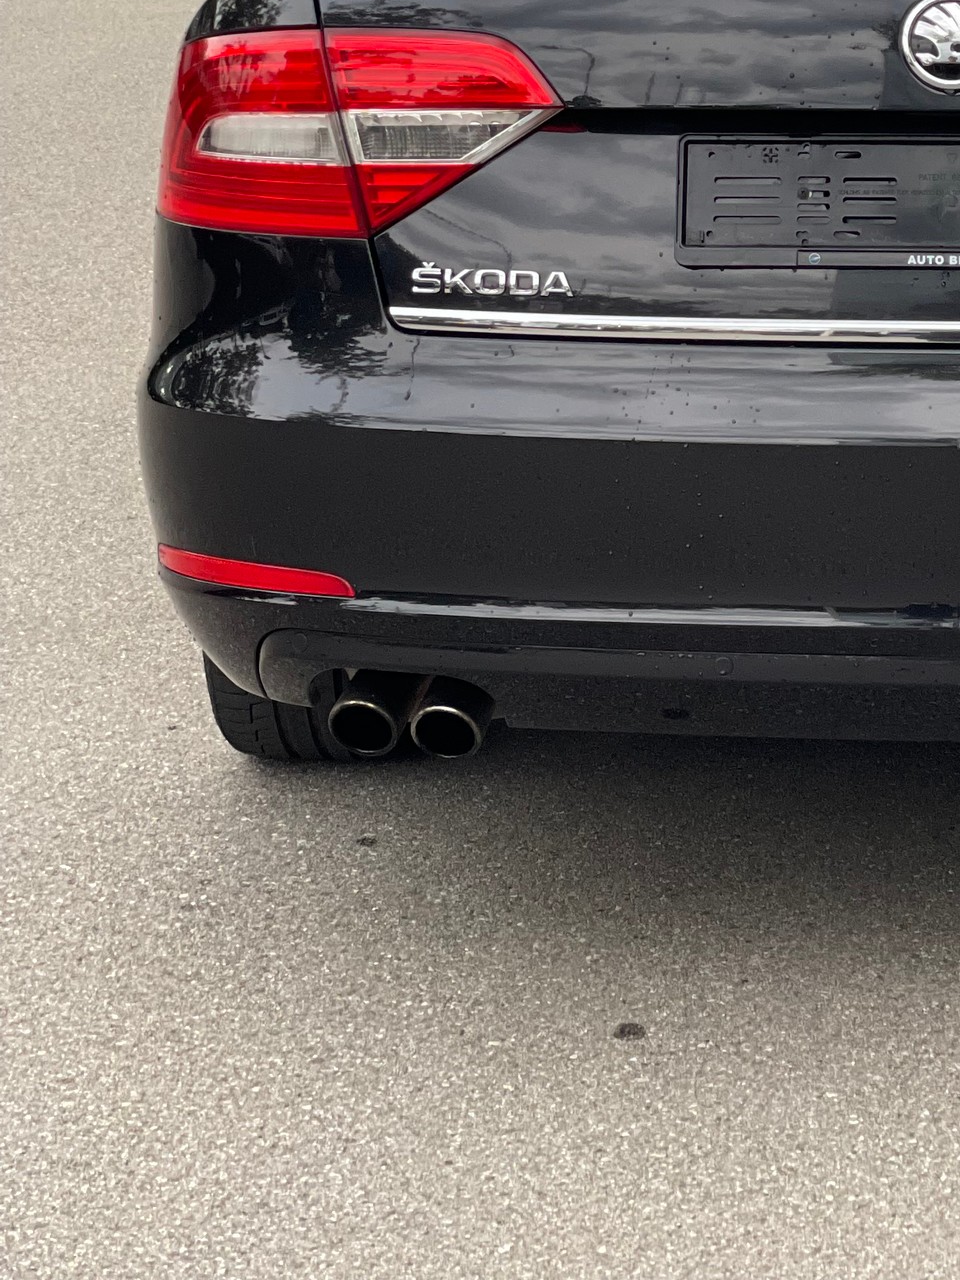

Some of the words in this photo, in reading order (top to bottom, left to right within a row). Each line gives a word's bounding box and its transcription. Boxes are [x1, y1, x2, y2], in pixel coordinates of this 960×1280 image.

[919, 173, 946, 181] PATENT
[907, 255, 945, 265] AUTO
[412, 261, 573, 297] ŠKODA
